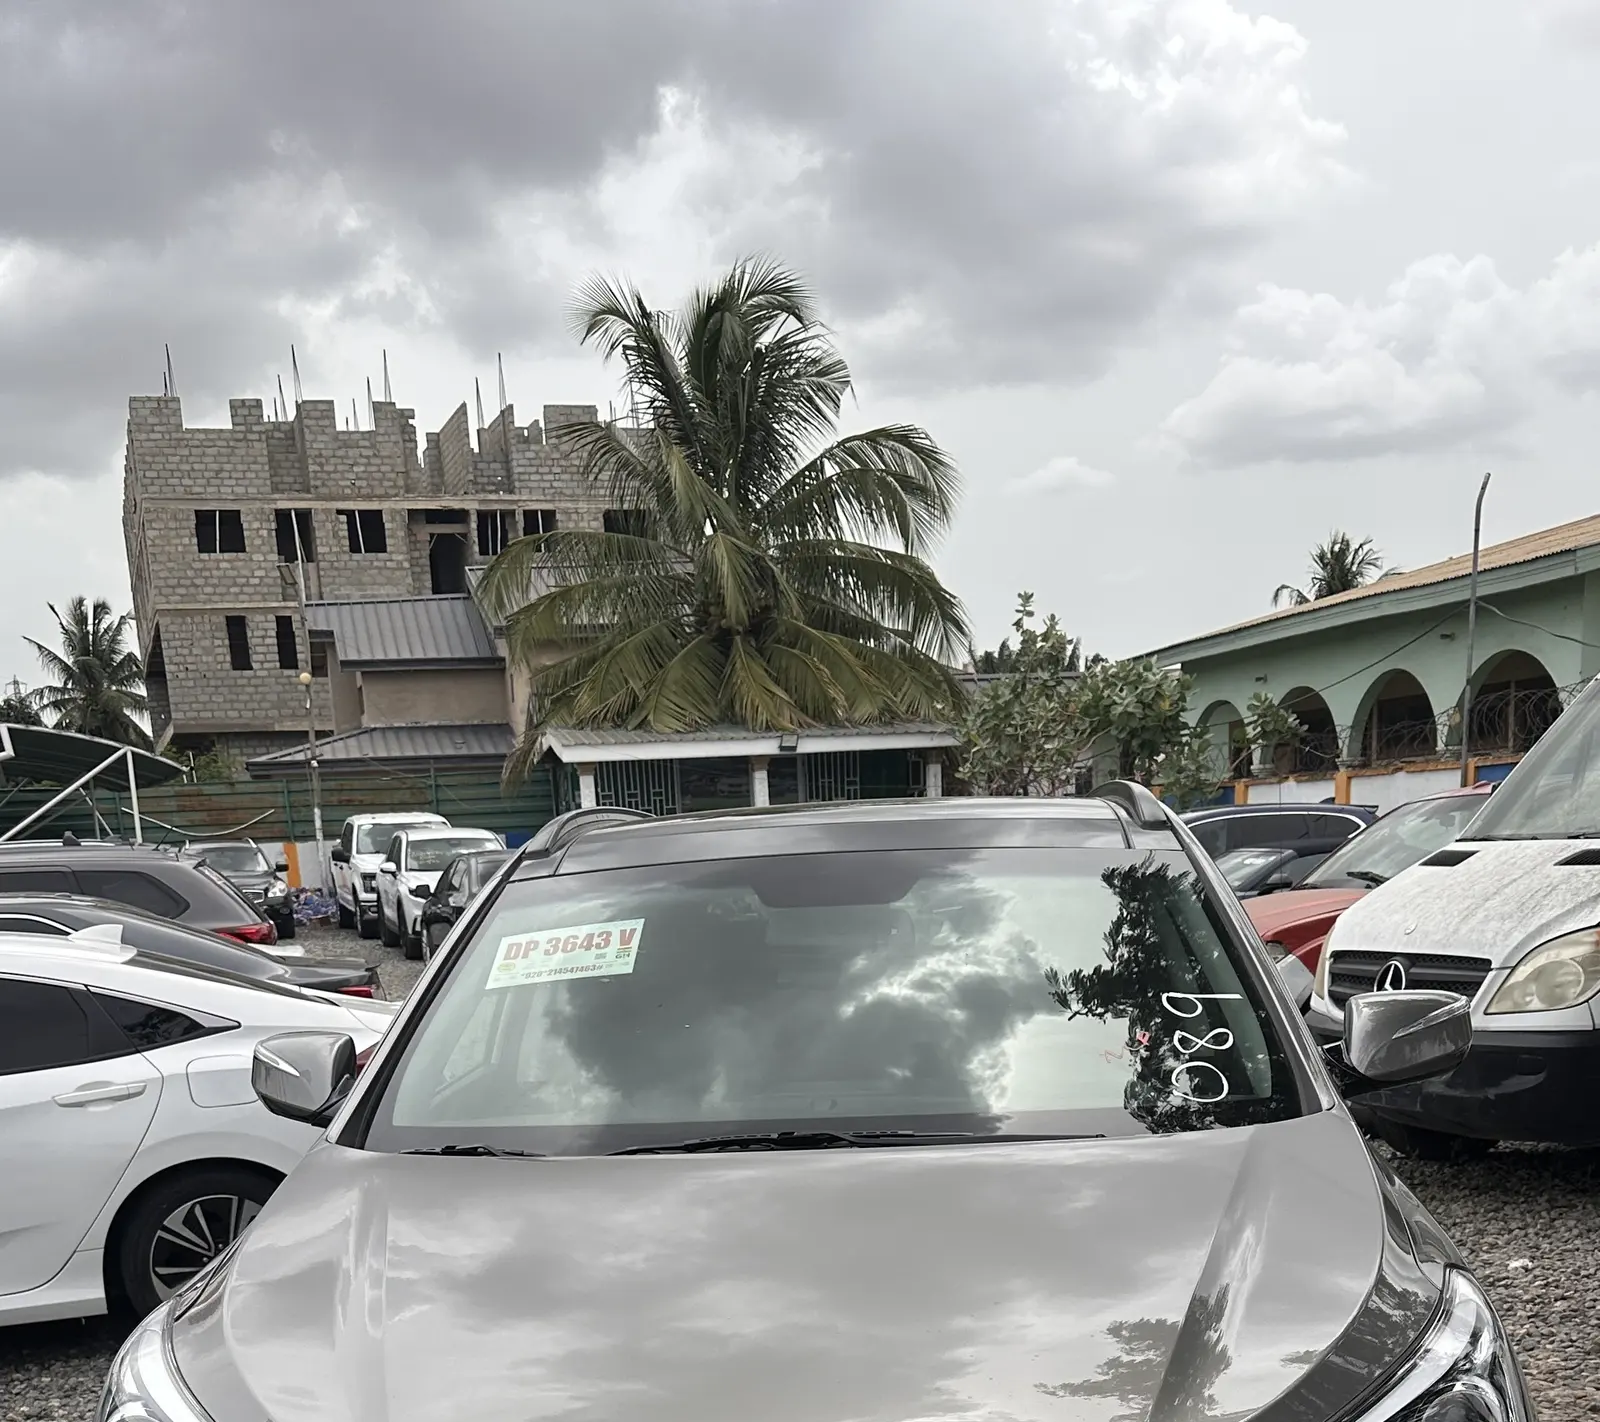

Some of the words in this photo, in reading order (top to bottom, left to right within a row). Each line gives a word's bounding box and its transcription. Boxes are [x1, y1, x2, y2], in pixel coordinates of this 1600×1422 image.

[503, 940, 540, 961] DP
[543, 930, 613, 957] 3643
[619, 928, 638, 947] V
